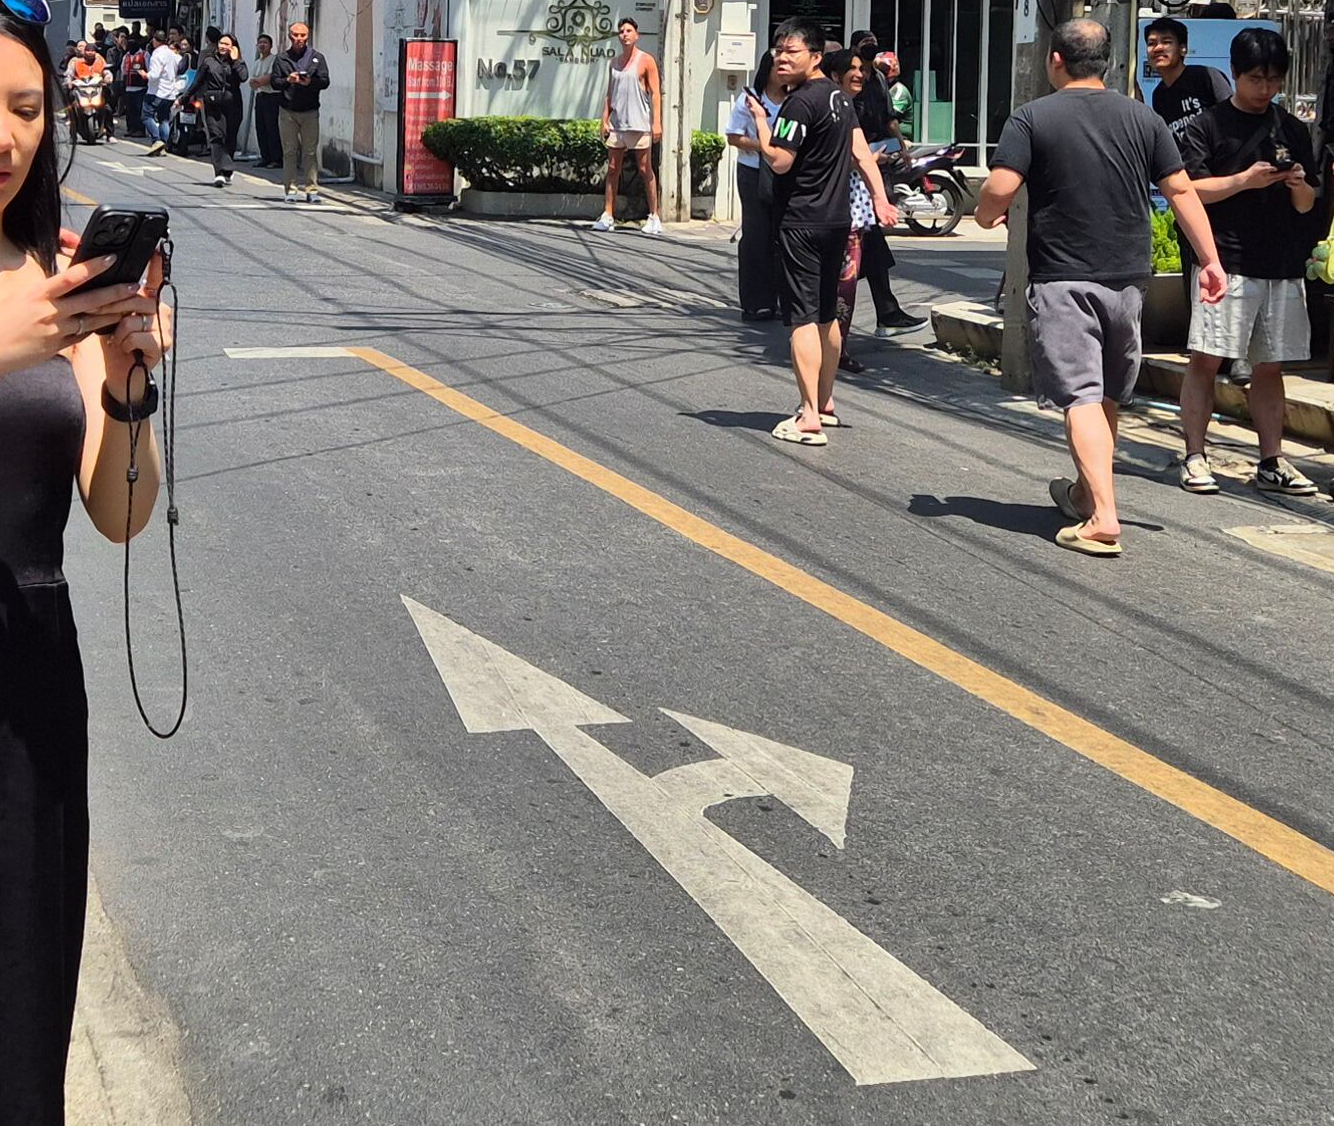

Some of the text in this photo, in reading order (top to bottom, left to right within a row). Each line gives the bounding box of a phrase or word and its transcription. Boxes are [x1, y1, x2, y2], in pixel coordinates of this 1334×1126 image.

[542, 47, 616, 58] SALA NUAD
[408, 57, 453, 75] Massage
